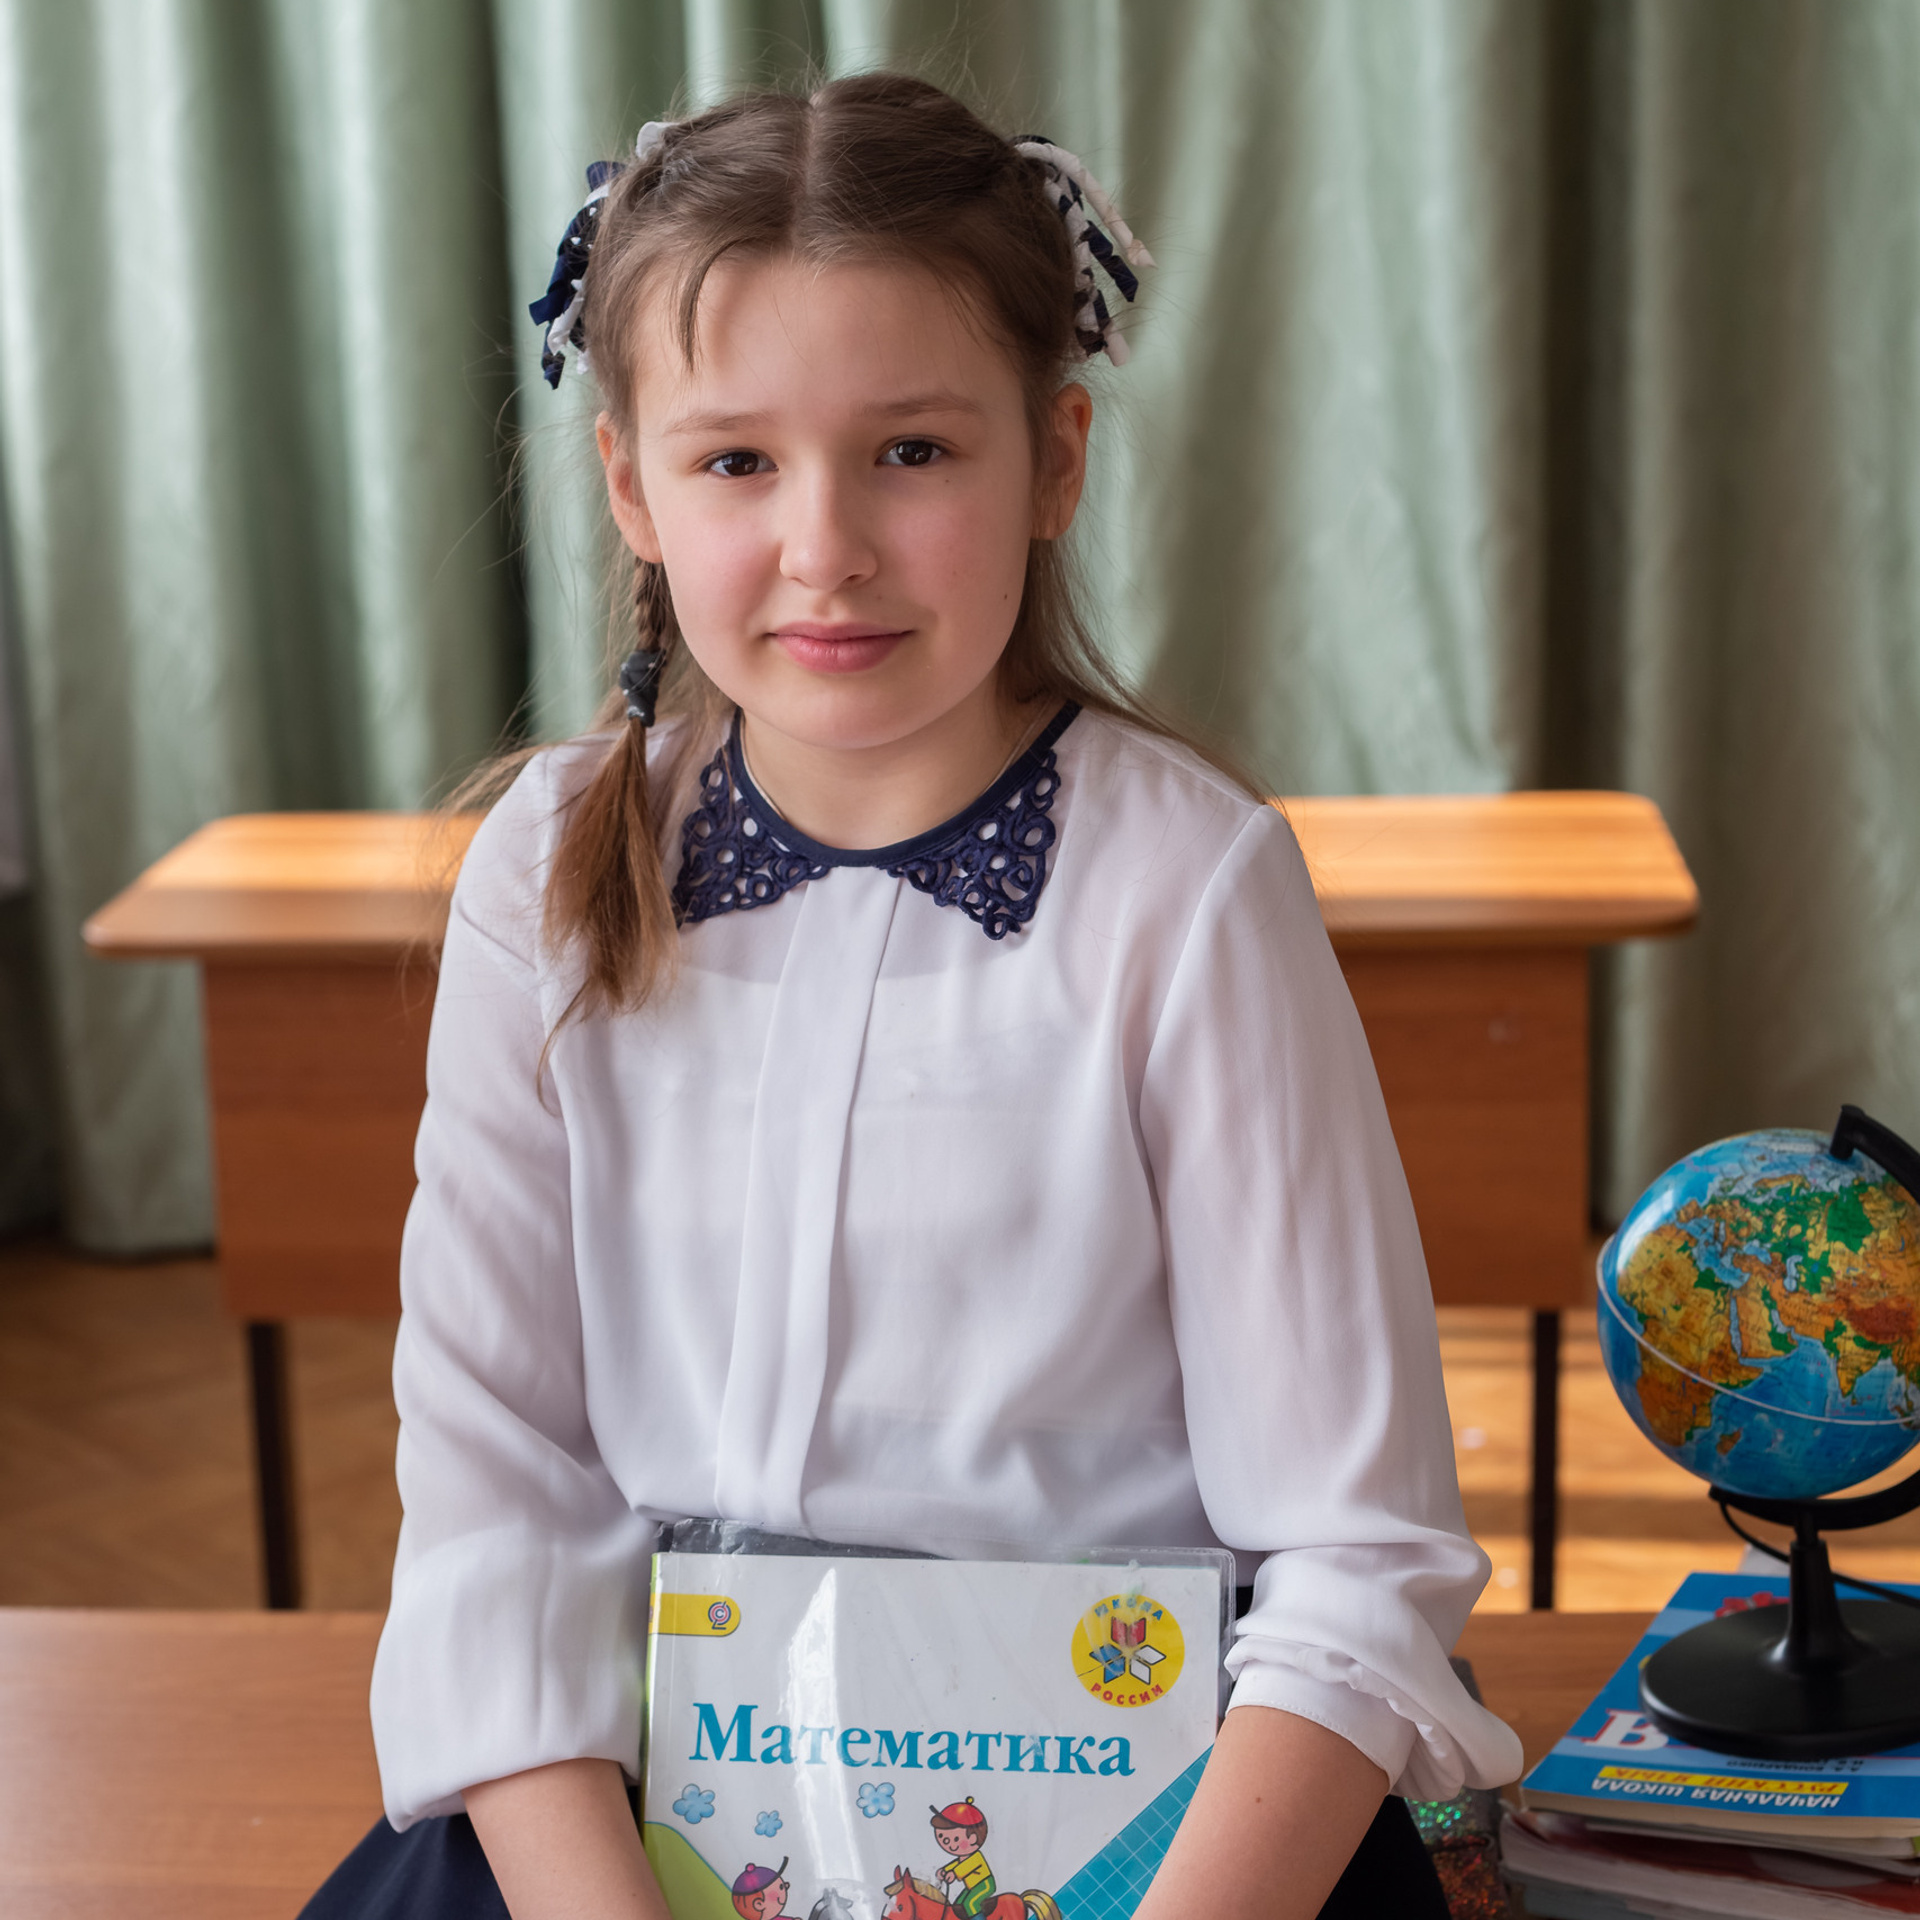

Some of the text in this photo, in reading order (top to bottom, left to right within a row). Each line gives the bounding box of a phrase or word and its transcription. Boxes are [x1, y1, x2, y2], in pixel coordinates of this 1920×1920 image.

[1090, 1684, 1164, 1705] РОССИИ
[688, 1702, 1137, 1777] Математика
[1614, 1768, 1689, 1786] ЯЗЫК
[1591, 1777, 1841, 1808] НАЧАЛЬНАЯ ШКОЛА
